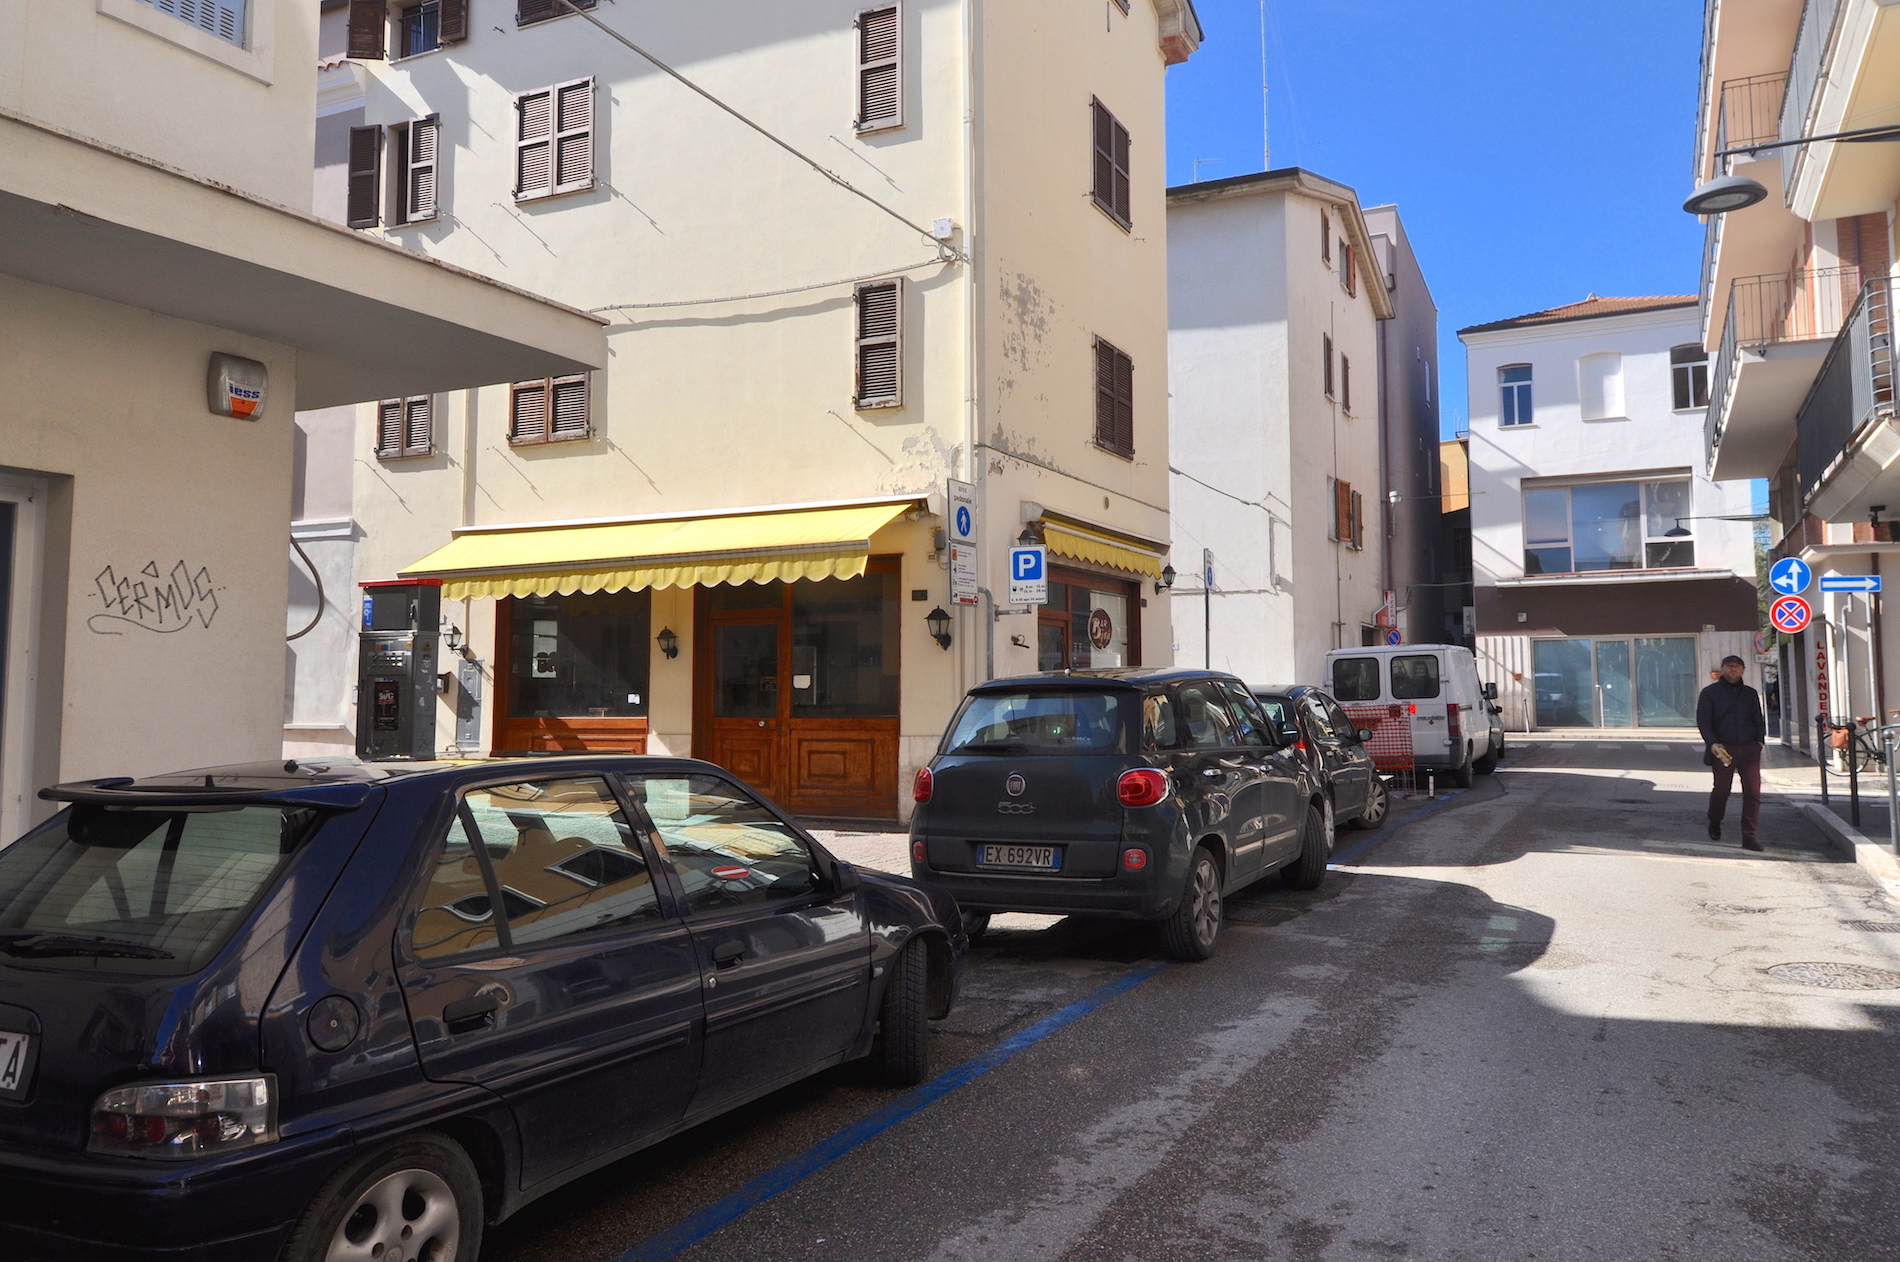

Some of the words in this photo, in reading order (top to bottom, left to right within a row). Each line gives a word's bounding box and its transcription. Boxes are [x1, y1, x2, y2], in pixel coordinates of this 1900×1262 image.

[1018, 553, 1036, 577] P
[1010, 780, 1022, 791] FIAT
[985, 846, 1002, 863] EX
[1007, 847, 1051, 866] 692VR
